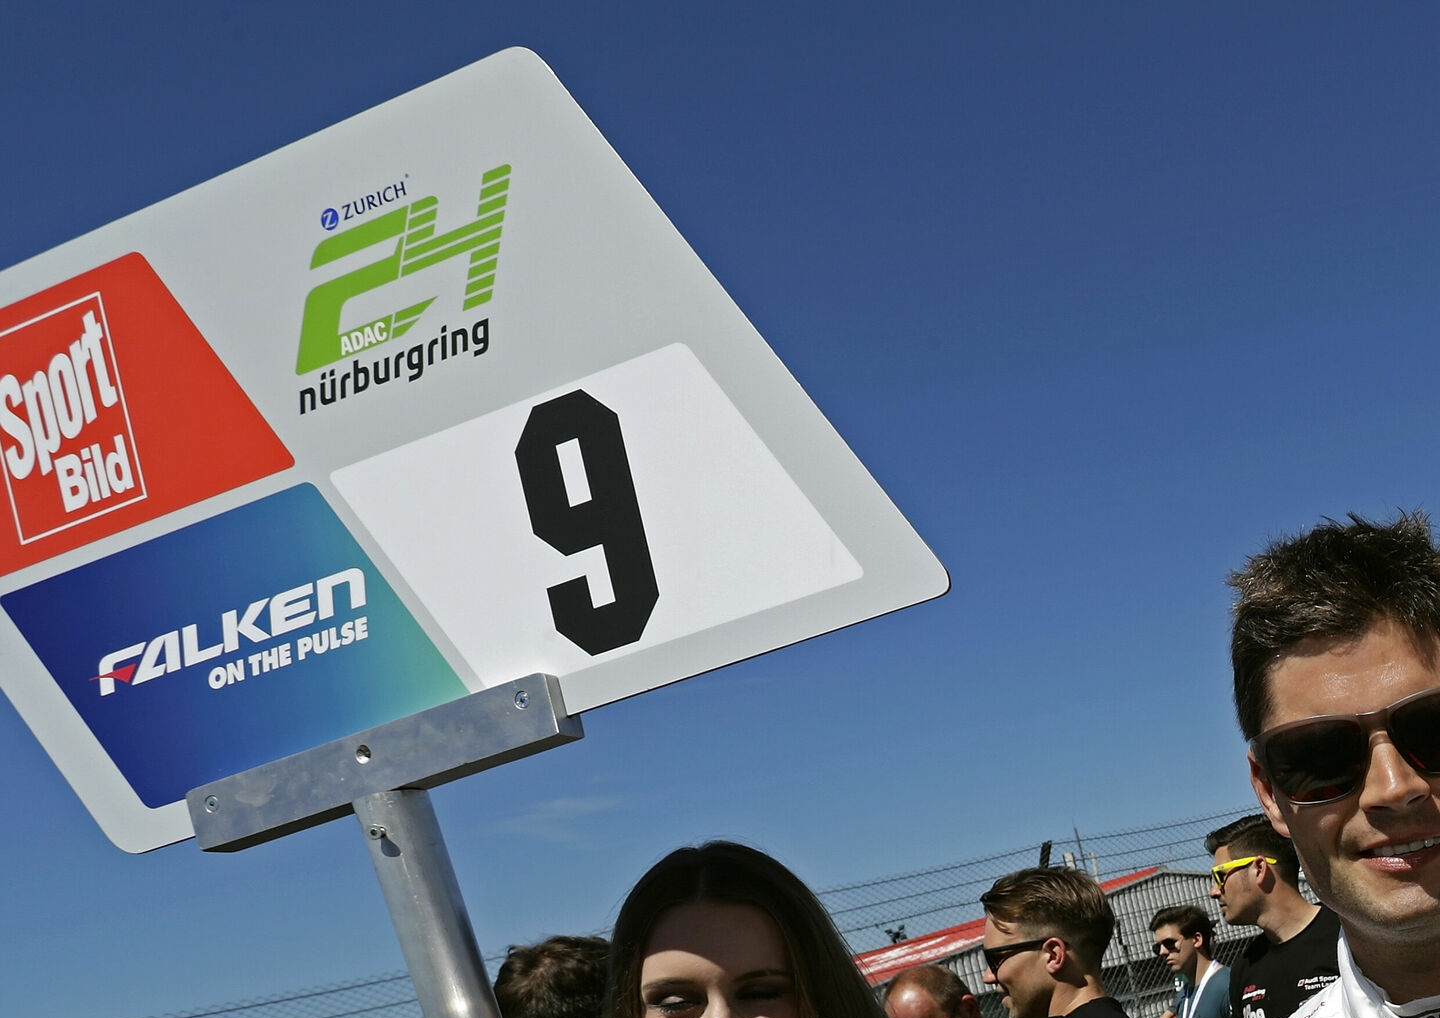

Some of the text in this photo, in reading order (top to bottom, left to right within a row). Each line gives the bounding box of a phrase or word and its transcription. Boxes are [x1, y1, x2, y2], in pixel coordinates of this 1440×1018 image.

[342, 181, 407, 221] ZURICH
[300, 318, 489, 415] nürburgring
[340, 321, 388, 355] ADAC
[0, 309, 119, 480] Sport
[54, 434, 134, 513] Bild
[515, 389, 660, 657] 9
[92, 567, 367, 697] FALKEN
[208, 616, 369, 690] ON THE PULSE
